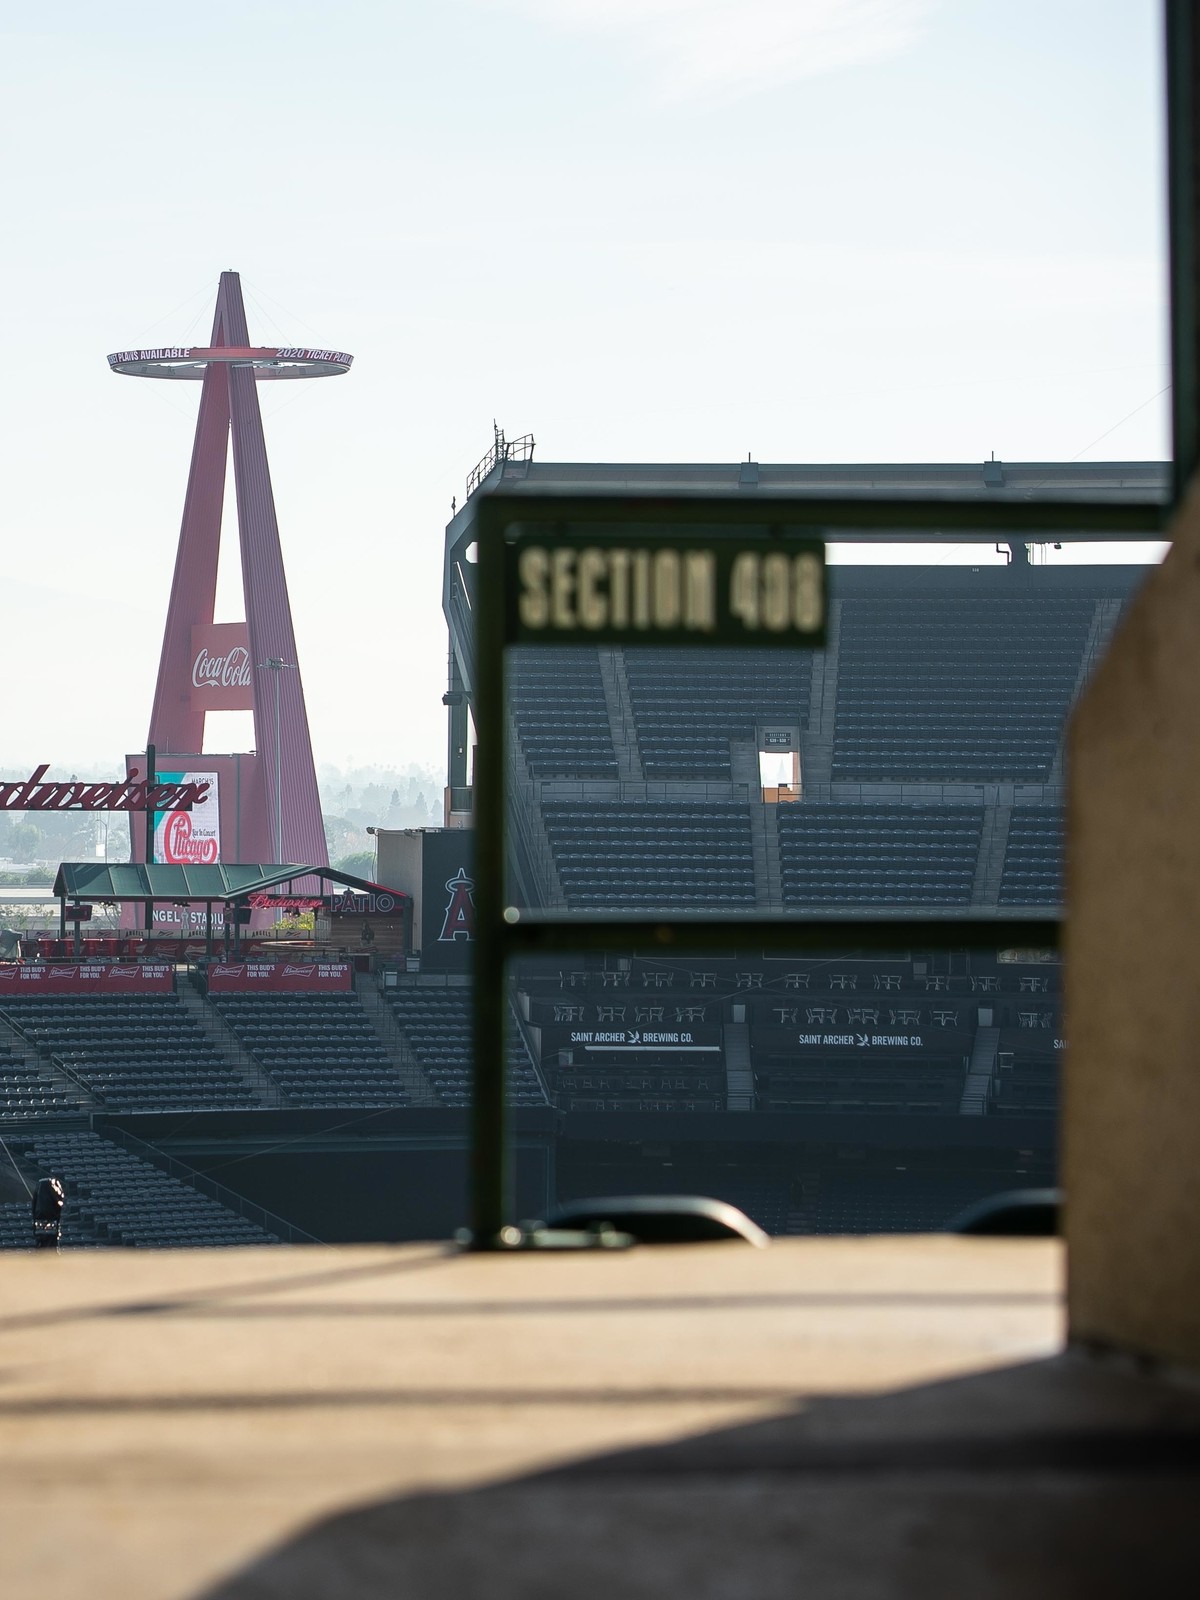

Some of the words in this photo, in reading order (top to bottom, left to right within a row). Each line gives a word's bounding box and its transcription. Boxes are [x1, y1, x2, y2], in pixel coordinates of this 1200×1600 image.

[118, 350, 139, 362] PLANS
[140, 348, 190, 360] AVAILABLE
[276, 348, 304, 358] 2020
[306, 349, 335, 361] TICKET
[519, 546, 717, 632] SECTION
[730, 551, 824, 632] 408
[191, 777, 208, 785] MARCH
[164, 810, 218, 864] Chicago
[330, 893, 395, 913] PATIO
[152, 910, 180, 922] NGEL
[190, 912, 224, 925] STAIU
[570, 1032, 594, 1042] SAINT
[594, 1032, 626, 1042] ARCHER
[643, 1032, 679, 1043] BREWING
[680, 1033, 694, 1043] CO.
[799, 1034, 822, 1045] SAINT
[822, 1035, 854, 1045] ARCHER
[871, 1035, 909, 1046] BREWING
[910, 1036, 923, 1046] CO.
[1053, 1039, 1070, 1049] SAI
